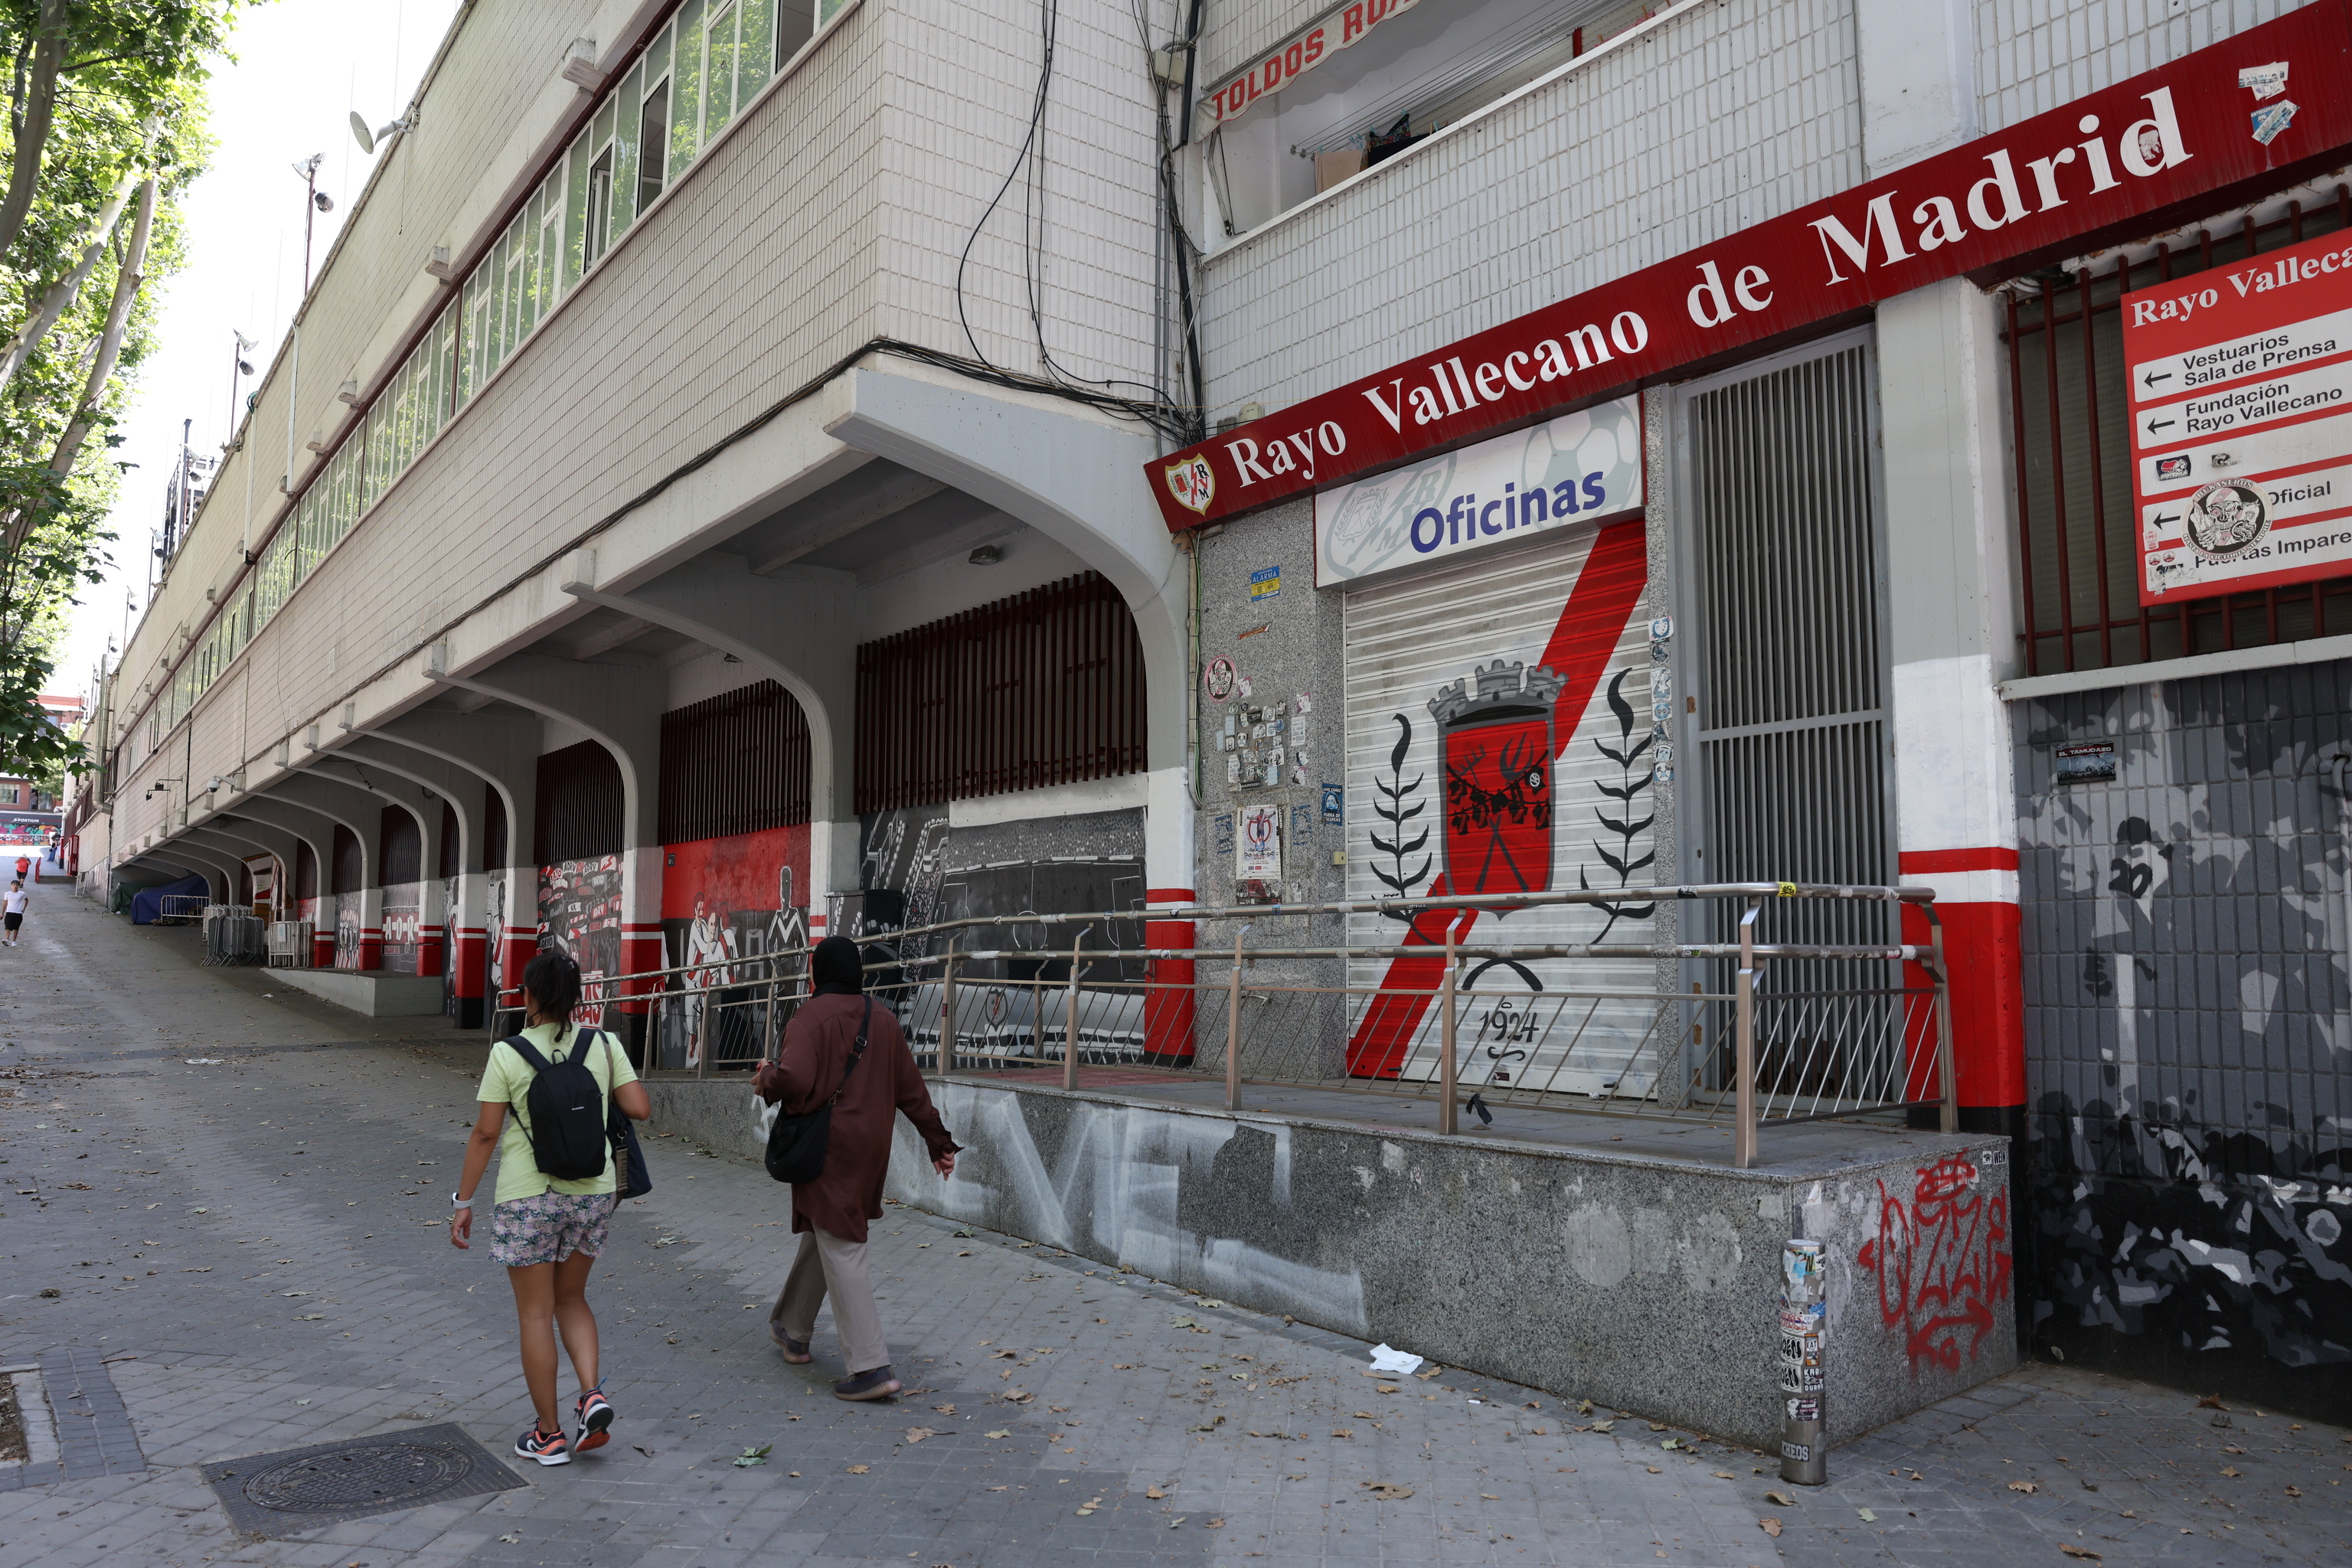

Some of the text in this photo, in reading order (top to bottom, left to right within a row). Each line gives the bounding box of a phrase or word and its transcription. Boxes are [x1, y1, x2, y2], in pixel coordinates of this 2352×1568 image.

[1212, 28, 1324, 120] TOLDOS
[1223, 86, 2194, 488] Rayo Vallecano de Madrid
[2132, 288, 2218, 328] Rayo
[2183, 335, 2289, 370] Vestuarios
[2184, 339, 2337, 387] Sala de Prensa
[2186, 384, 2289, 417] Fundación
[2187, 388, 2343, 433] Rayo Vallecano
[2196, 478, 2254, 498] BUKANEROS
[1410, 471, 1606, 554] Oficinas
[2182, 519, 2272, 560] HASTA LA VICTORIA SIEMPRE
[1253, 571, 1277, 583] ALARMA
[1654, 707, 1671, 717] 1992
[550, 868, 562, 881] RAYO
[2109, 858, 2153, 899] 20
[1478, 1010, 1540, 1042] 1924
[1994, 1151, 2006, 1164] WEIN
[1807, 1340, 1817, 1348] EAT
[1782, 1440, 1809, 1462] KHEOS
